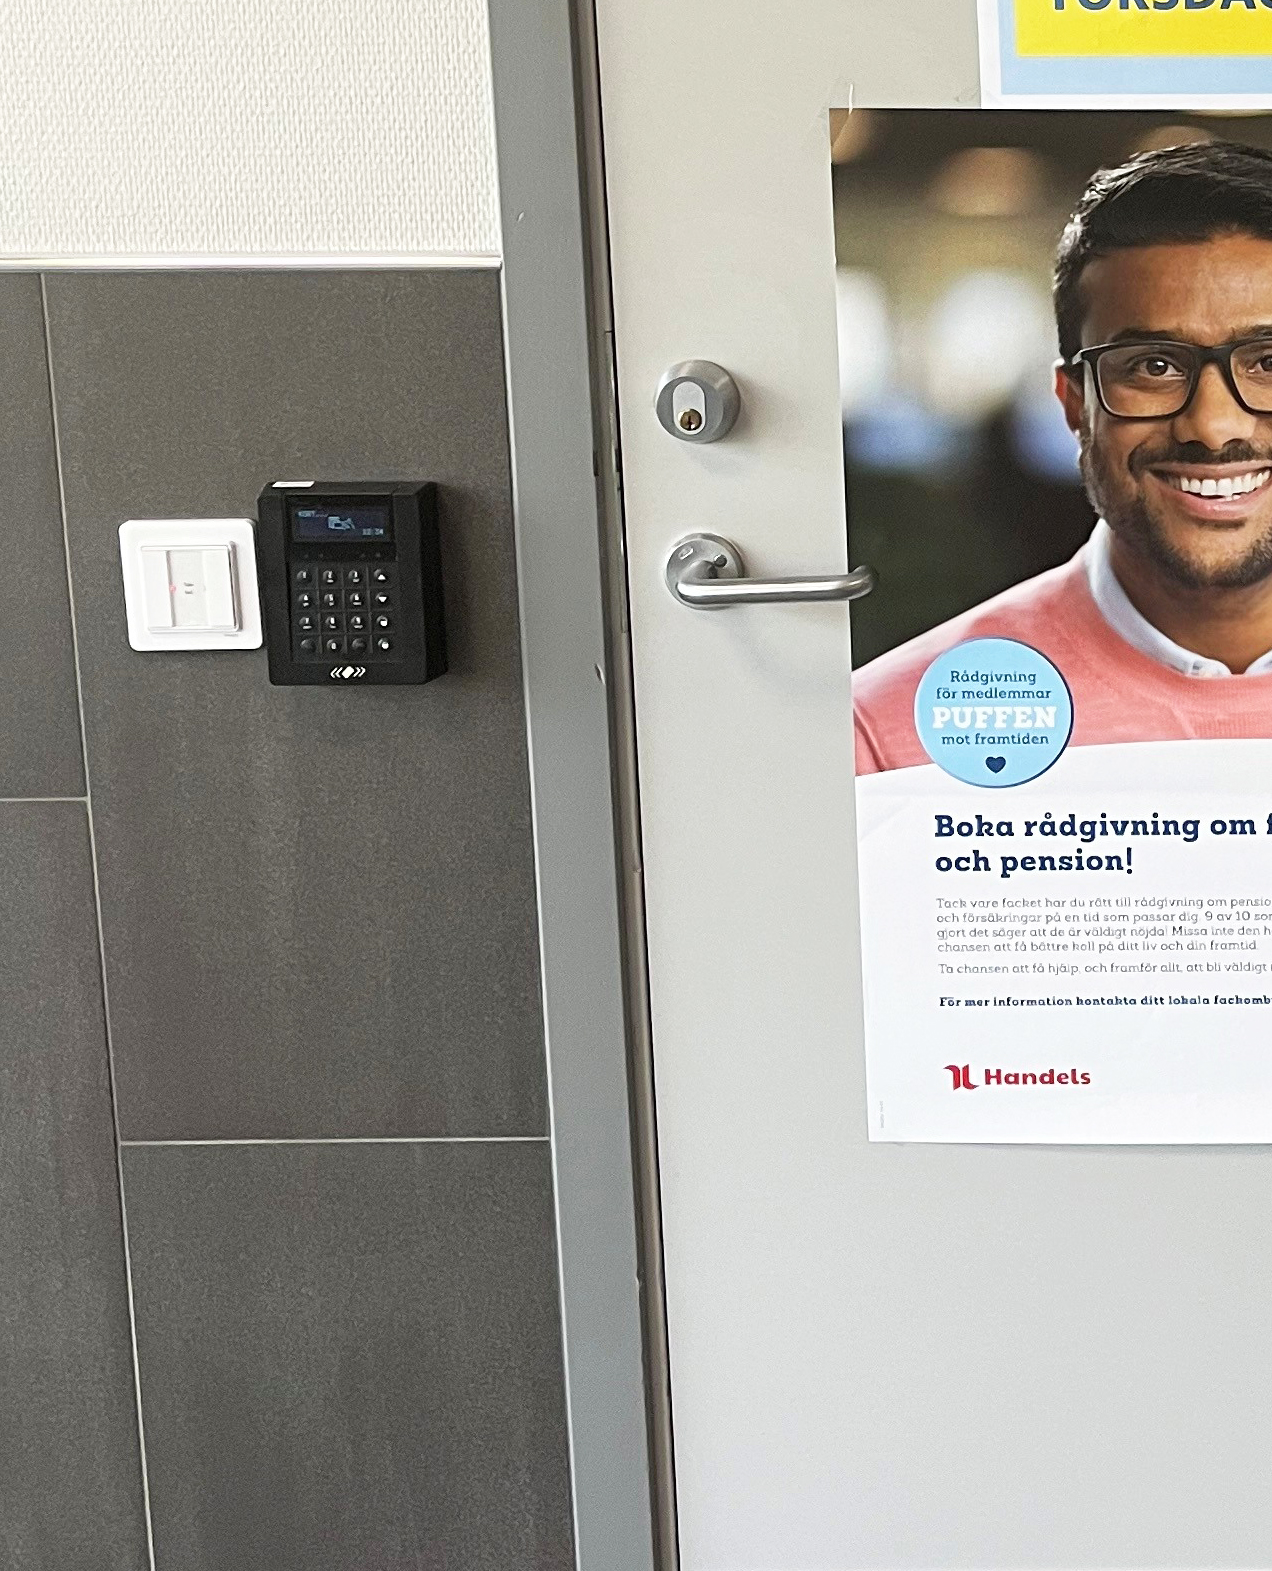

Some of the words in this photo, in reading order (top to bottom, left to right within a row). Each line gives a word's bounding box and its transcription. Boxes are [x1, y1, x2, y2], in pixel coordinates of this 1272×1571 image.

[950, 670, 1037, 685] Rådgivning
[936, 687, 958, 699] för
[962, 688, 1052, 699] medlemmar
[932, 706, 1057, 729] PUFFEN
[941, 734, 971, 745] mot
[974, 733, 1049, 744] framtiden
[934, 814, 1015, 837] Boka
[1024, 812, 1200, 843] rådgivning
[1210, 818, 1257, 836] om
[935, 849, 992, 872] och
[1000, 847, 1133, 879] pension!
[936, 898, 967, 909] Tack
[970, 900, 999, 908] vare
[1002, 898, 1042, 908] facket
[1044, 897, 1067, 908] har
[1070, 897, 1085, 908] du
[1089, 897, 1112, 907] rätt
[1115, 897, 1131, 907] till
[1134, 896, 1204, 910] rådgivning
[1207, 898, 1227, 907] om
[936, 912, 960, 923] och
[963, 912, 1042, 925] försäkringar
[1045, 912, 1060, 924] på
[1064, 913, 1080, 922] en
[1083, 911, 1100, 922] tid
[1103, 913, 1129, 922] som
[1133, 912, 1176, 924] passar
[1204, 911, 1213, 921] 9
[1216, 912, 1232, 921] av
[1235, 911, 1250, 921] 10
[937, 927, 966, 940] gjort
[969, 927, 989, 938] det
[992, 928, 1026, 939] säger
[1030, 927, 1047, 937] att
[1050, 926, 1065, 937] de
[1068, 927, 1081, 937] är
[1084, 926, 1127, 939] väldigt
[1171, 926, 1208, 936] Missa
[1211, 926, 1235, 936] inte
[1237, 925, 1260, 935] den
[937, 941, 990, 952] chansen
[993, 943, 1011, 952] att
[1014, 941, 1027, 952] få
[1030, 941, 1069, 952] bättre
[1072, 941, 1095, 951] koll
[1098, 941, 1114, 953] på
[1117, 940, 1139, 951] ditt
[1143, 940, 1157, 951] liv
[1160, 940, 1183, 951] och
[1186, 940, 1207, 950] din
[938, 963, 954, 974] Ta
[956, 963, 1009, 974] chansen
[1012, 964, 1030, 973] att
[1032, 963, 1045, 973] få
[1084, 962, 1107, 973] och
[1110, 962, 1157, 973] framför
[1186, 963, 1204, 972] att
[1206, 962, 1221, 972] bli
[1224, 961, 1268, 974] väldigt
[939, 996, 961, 1007] För
[964, 998, 990, 1007] mer
[993, 995, 1072, 1007] information
[1076, 996, 1136, 1006] kontakta
[1140, 995, 1165, 1005] ditt
[1168, 995, 1210, 1005] lokala
[984, 1066, 1092, 1087] Handels
